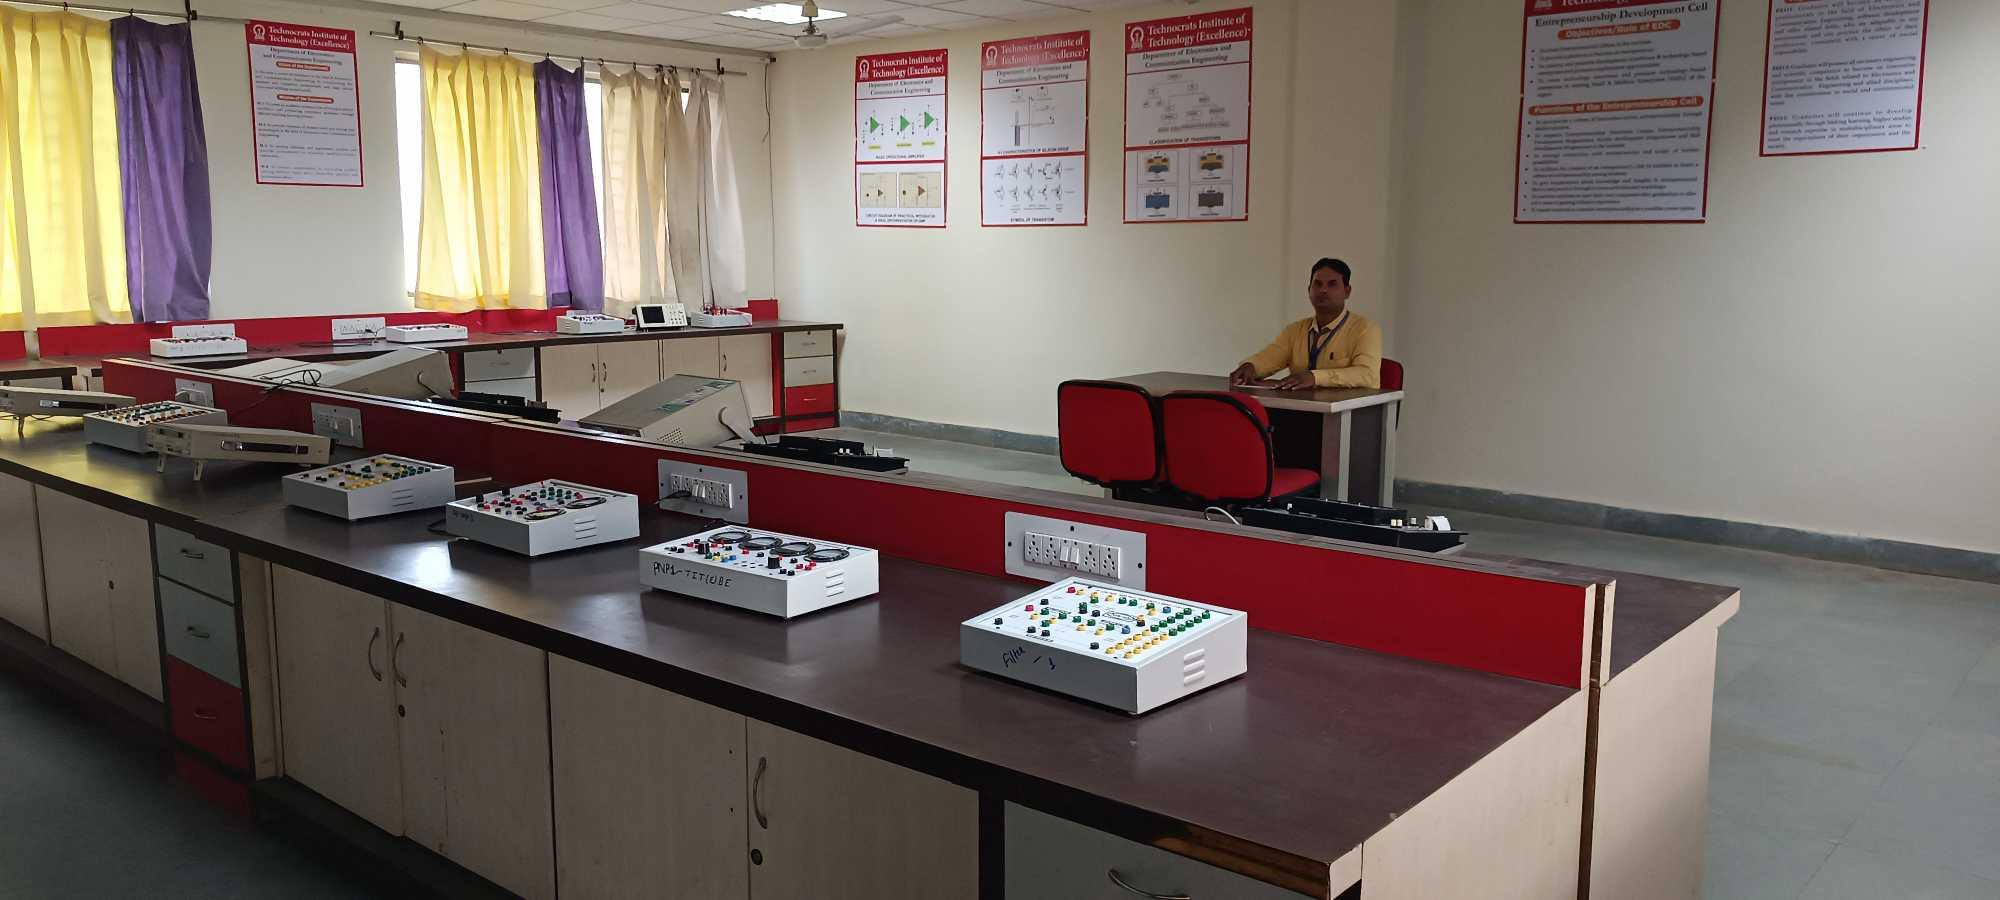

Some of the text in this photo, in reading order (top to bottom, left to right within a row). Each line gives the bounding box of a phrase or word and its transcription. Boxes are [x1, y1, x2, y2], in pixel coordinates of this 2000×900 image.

[1536, 2, 1708, 27] Entrepreneurship Development Cell
[269, 25, 310, 37] Technocrats
[311, 30, 339, 39] Institute
[1149, 13, 1246, 36] Technocrats Institute of
[270, 35, 350, 49] Technology (Excellence)
[1001, 36, 1084, 55] Technocrats Institute of
[1149, 28, 1248, 48] Technology (Excellence)
[872, 53, 943, 68] Technocrats Institute of
[872, 65, 945, 78] Technology (Excellence)
[1680, 97, 1698, 106] Cell
